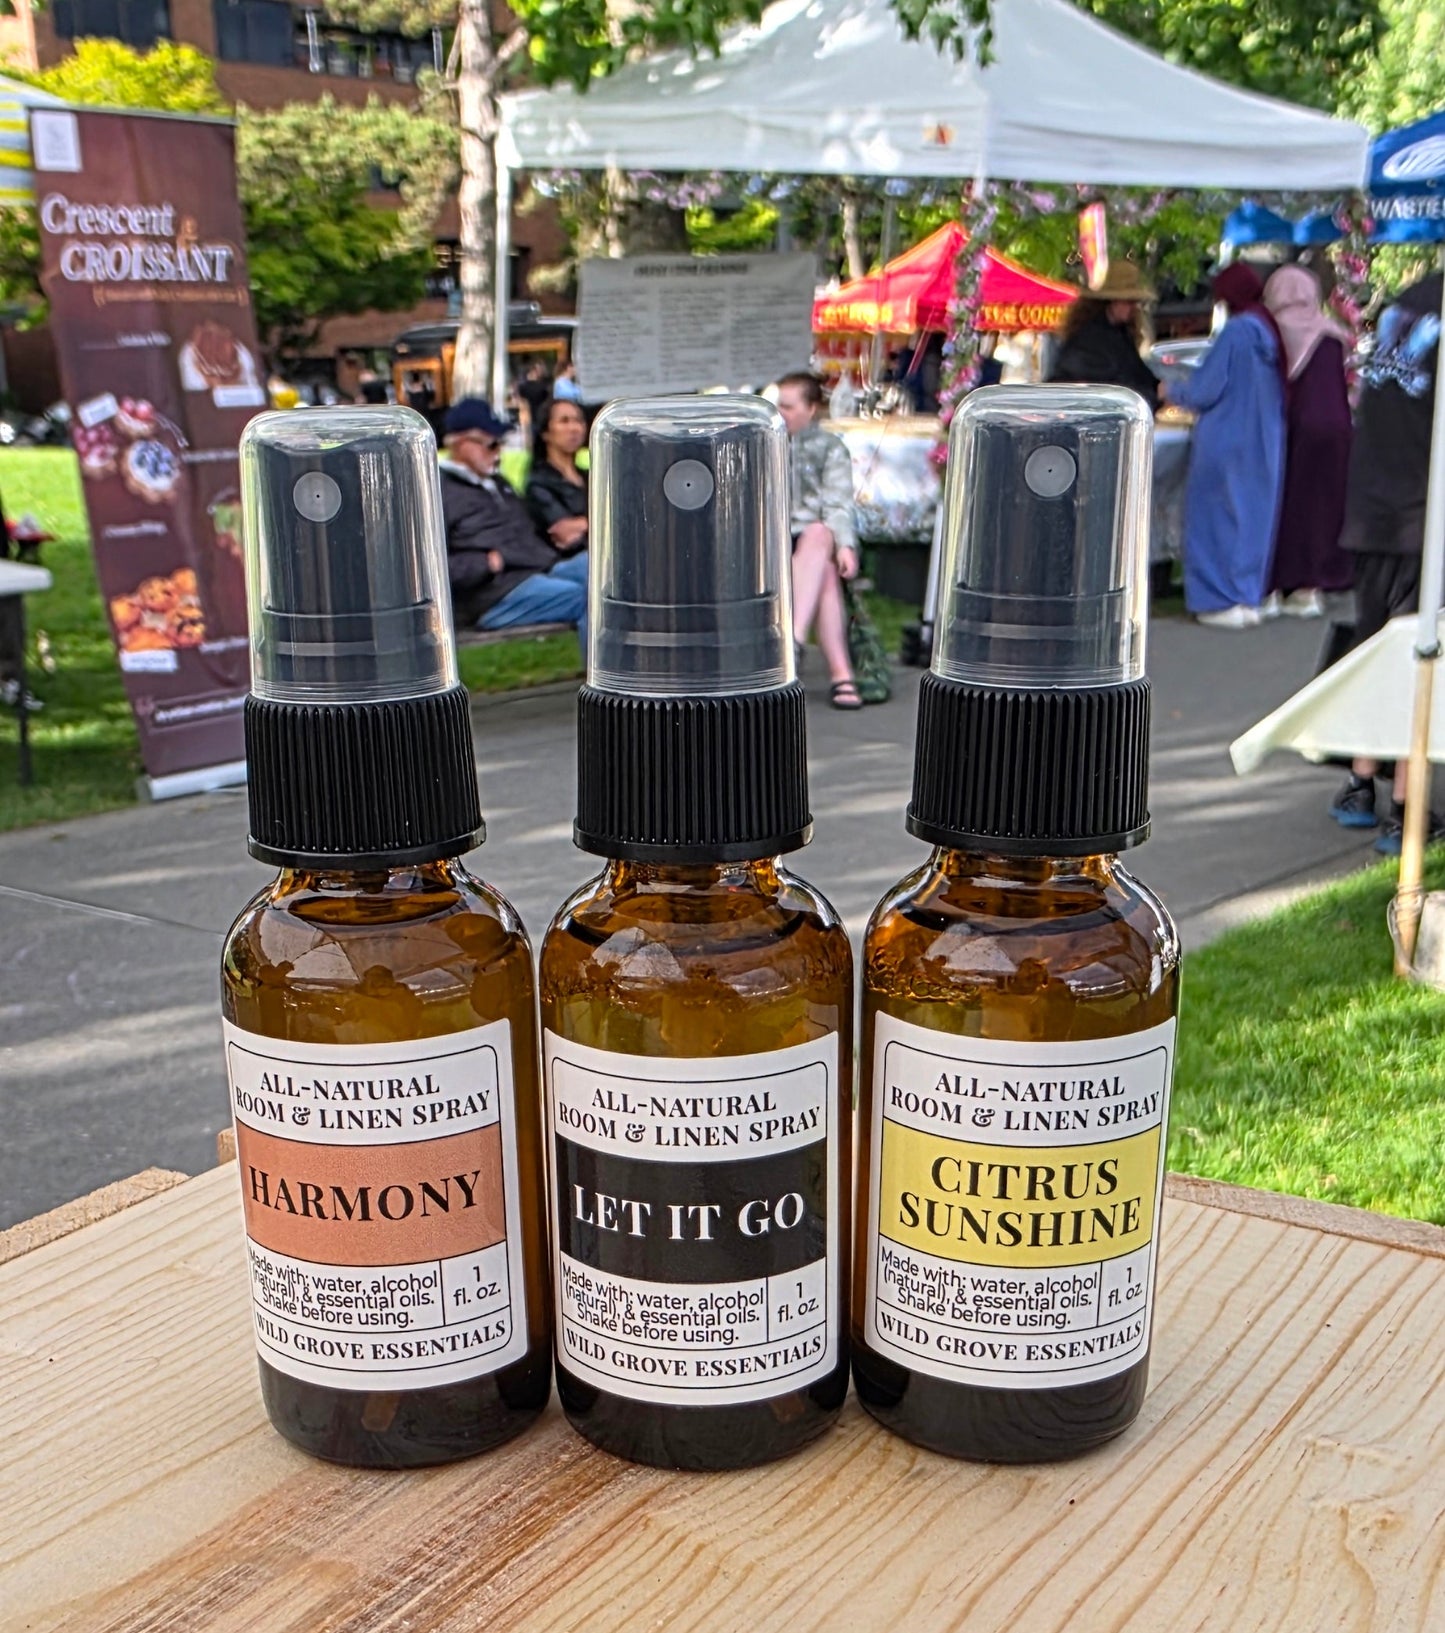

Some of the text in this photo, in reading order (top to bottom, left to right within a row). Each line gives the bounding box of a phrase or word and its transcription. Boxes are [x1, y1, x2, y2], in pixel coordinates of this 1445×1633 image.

[41, 192, 176, 236] Crescent
[60, 241, 234, 282] CROISSANT
[236, 1086, 490, 1129] ROOM & LINEN SPRAY
[260, 1072, 440, 1101] ALL-NATURAL
[592, 1088, 776, 1118] ALL-NATURAL
[935, 1073, 1125, 1102] ALL-NATURAL
[559, 1101, 820, 1147] ROOM & LINEN SPRAY
[891, 1086, 1160, 1131] ROOM & LINEN SPRAY
[249, 1165, 481, 1221] HARMONY
[931, 1156, 1119, 1201] CITRUS
[573, 1184, 804, 1240] LET IT GO
[899, 1191, 1141, 1247] SUNSHINE
[276, 1265, 310, 1287] with:
[312, 1276, 366, 1295] water,
[371, 1270, 437, 1293] alcohol
[473, 1266, 480, 1282] 1
[562, 1261, 763, 1312] Made with: water, alcohol
[796, 1282, 802, 1298] 1
[881, 1246, 1097, 1297] Made with: water, alcohol
[884, 1263, 1092, 1310] (natural), & essential oils.
[1126, 1267, 1132, 1283] 1
[263, 1286, 414, 1328] Shake before using.
[303, 1287, 312, 1303] &
[317, 1290, 394, 1308] essential
[400, 1290, 434, 1307] oils.
[453, 1282, 501, 1306] fl. oz.
[566, 1280, 759, 1326] (natural), & essential oils.
[778, 1304, 793, 1322] fl.
[898, 1287, 1071, 1329] Shake before using.
[1108, 1288, 1122, 1307] fl.
[256, 1311, 505, 1360] WILD GROVE ESSENTIALS
[577, 1302, 739, 1345] Shake before using.
[881, 1311, 1141, 1360] WILD GROVE ESSENTIALS
[566, 1327, 821, 1376] WILD GROVE ESSENTIALS
